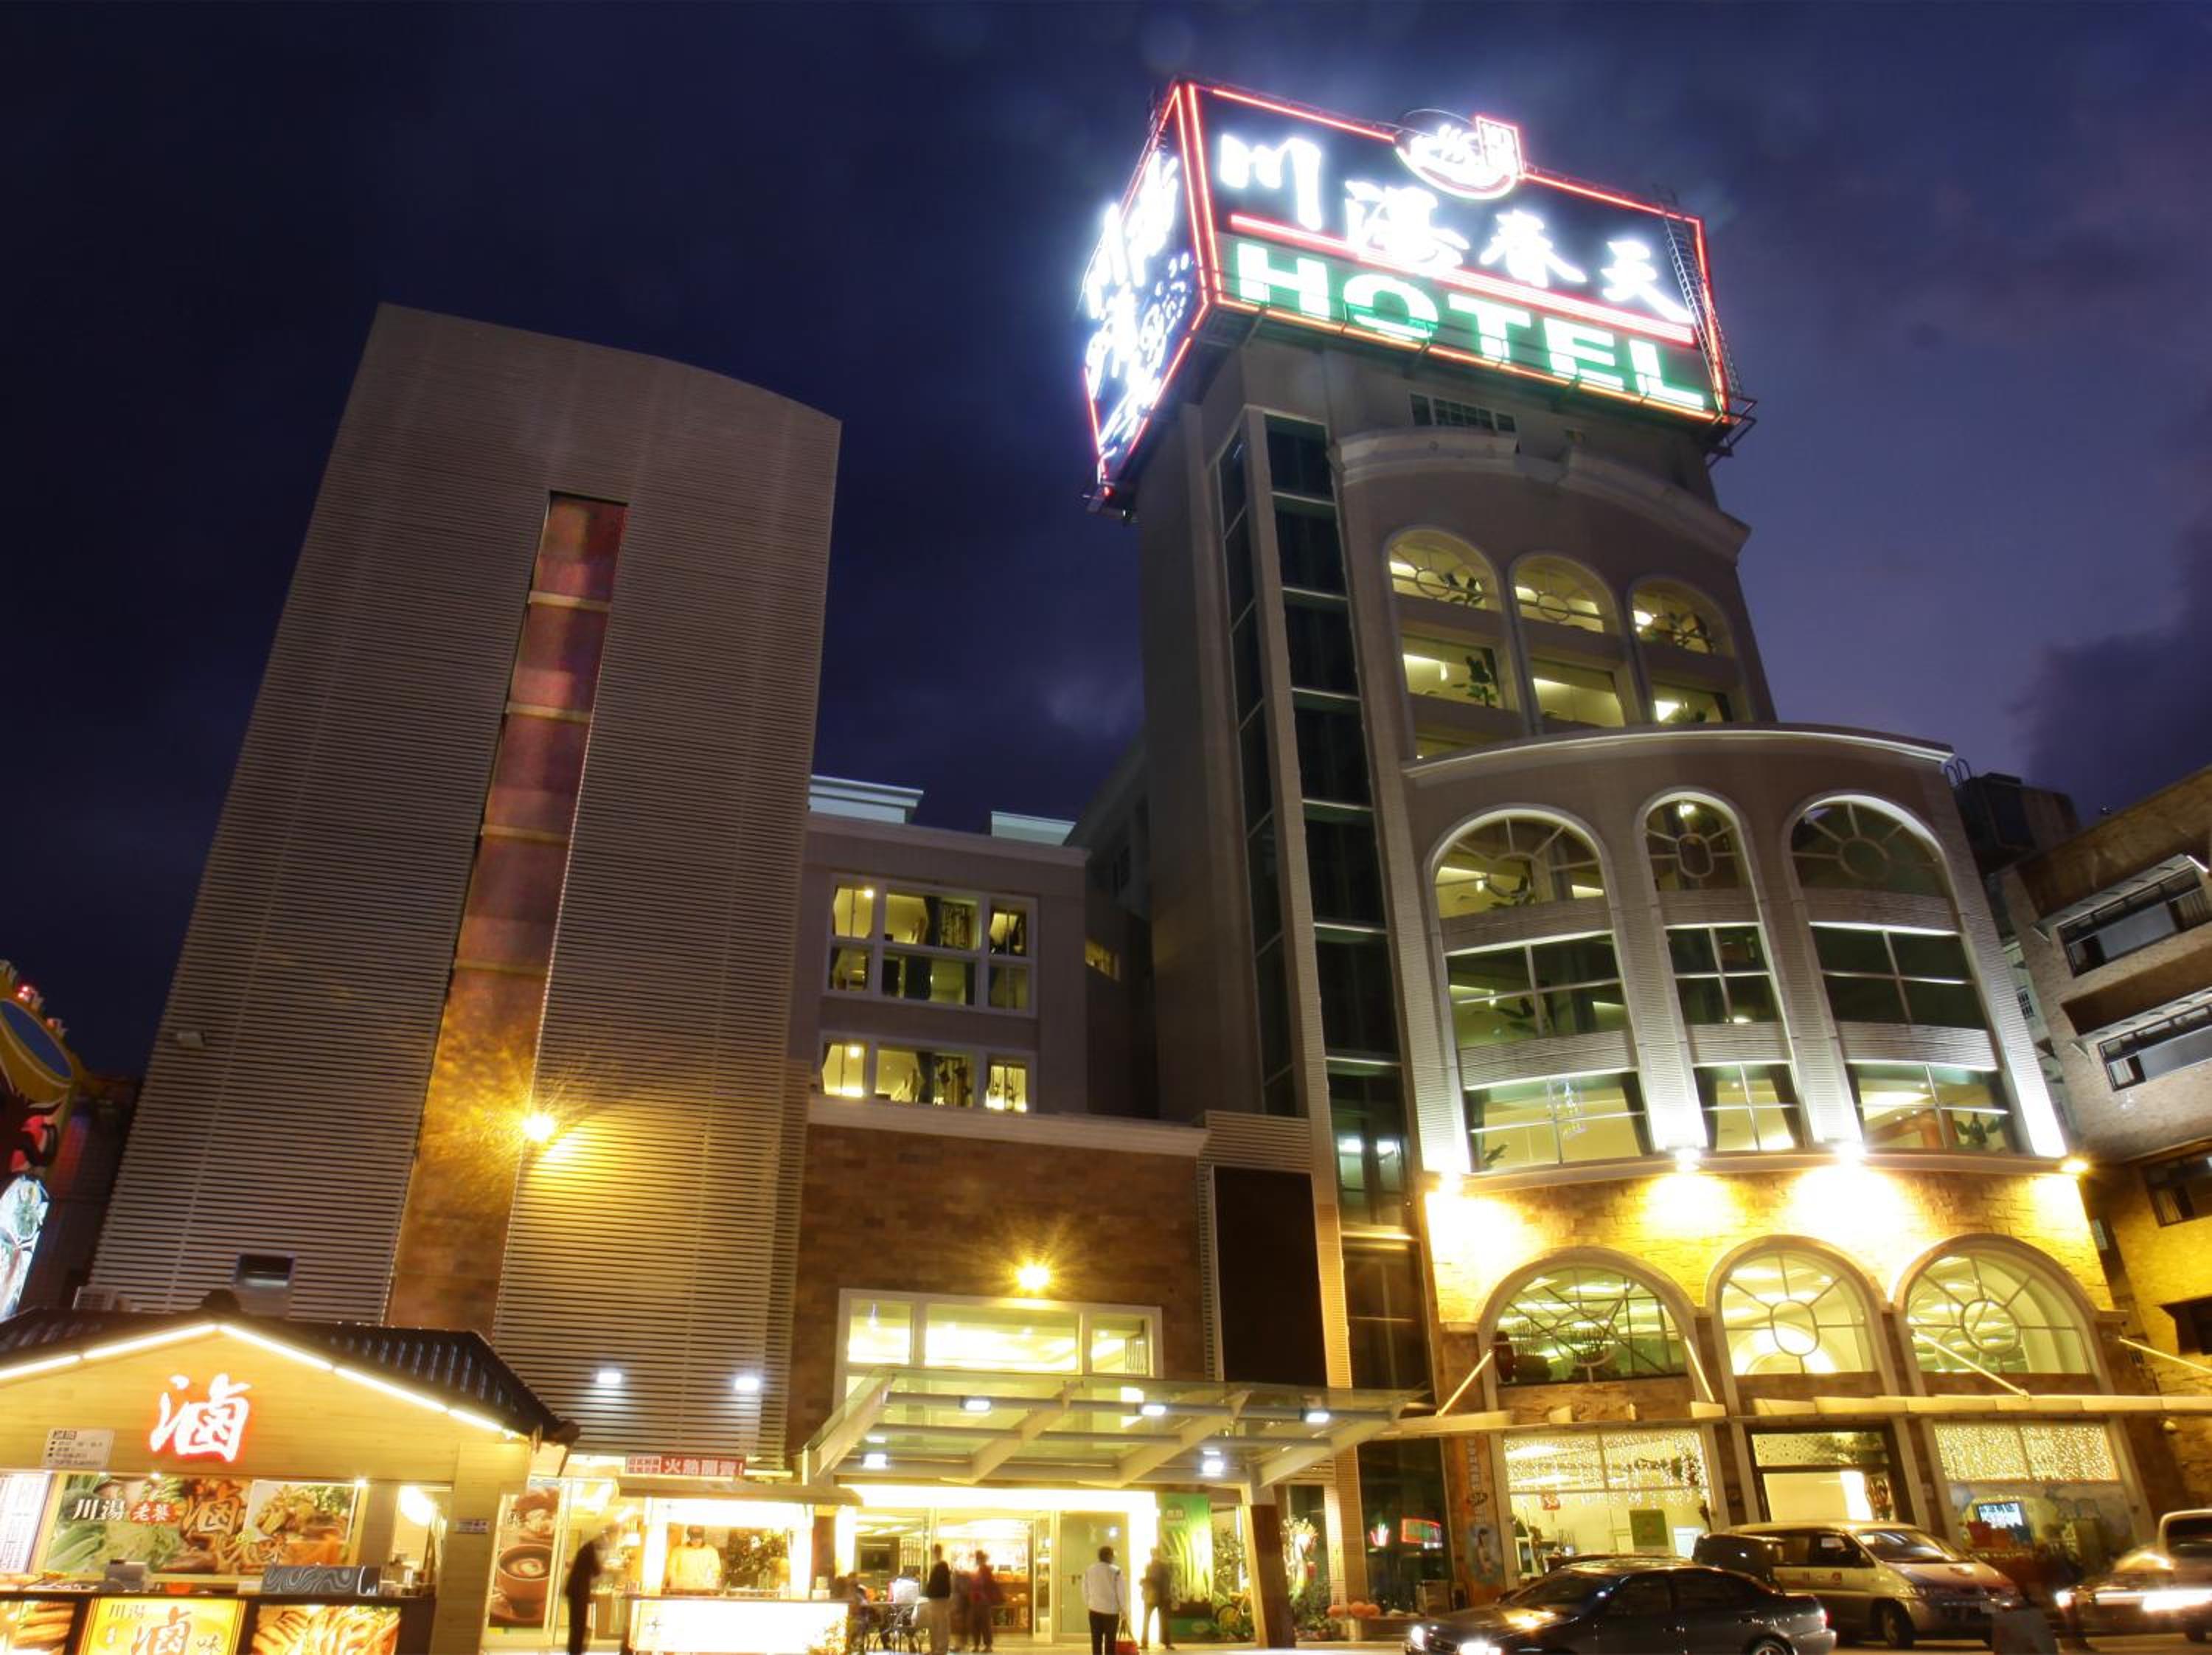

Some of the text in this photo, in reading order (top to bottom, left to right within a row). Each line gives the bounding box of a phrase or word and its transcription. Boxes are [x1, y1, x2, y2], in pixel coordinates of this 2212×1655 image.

[1220, 133, 1696, 325] 川湯春天
[1237, 241, 1705, 412] HOTEL
[149, 1373, 251, 1463] 滷
[72, 1498, 125, 1521] 川湯
